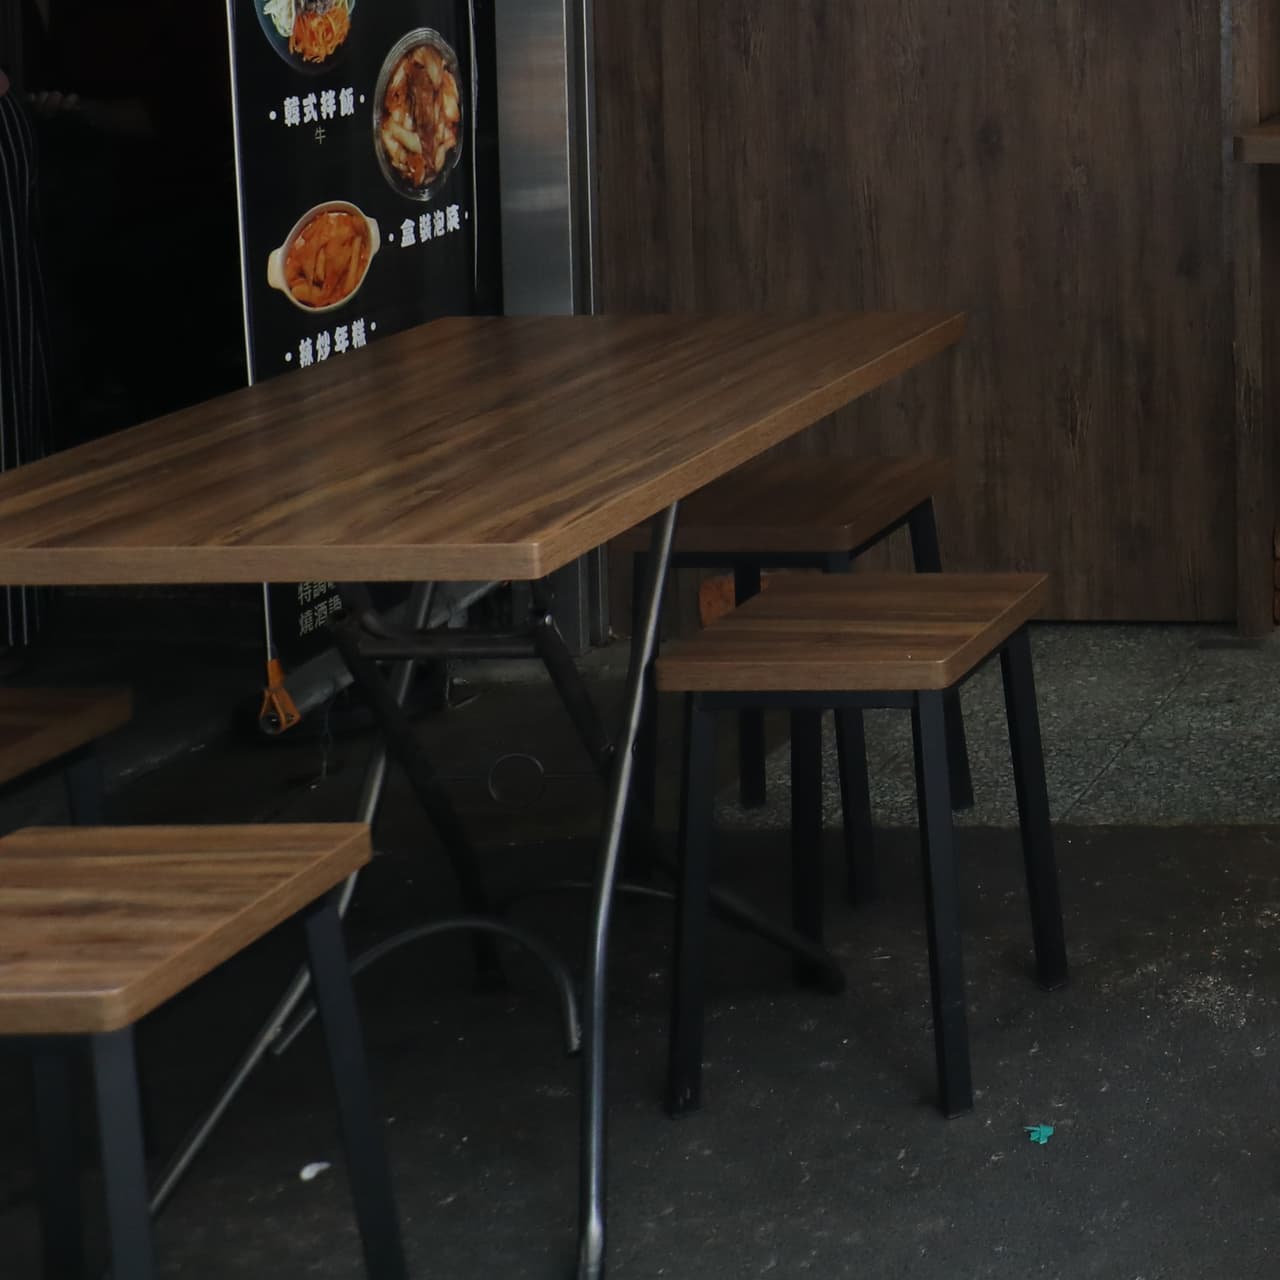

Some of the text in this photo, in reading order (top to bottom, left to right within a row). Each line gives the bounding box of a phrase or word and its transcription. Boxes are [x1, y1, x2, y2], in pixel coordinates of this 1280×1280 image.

[283, 87, 355, 128] 韓式拌飯
[315, 127, 326, 144] 牛
[298, 320, 367, 368] 辣炒年糕
